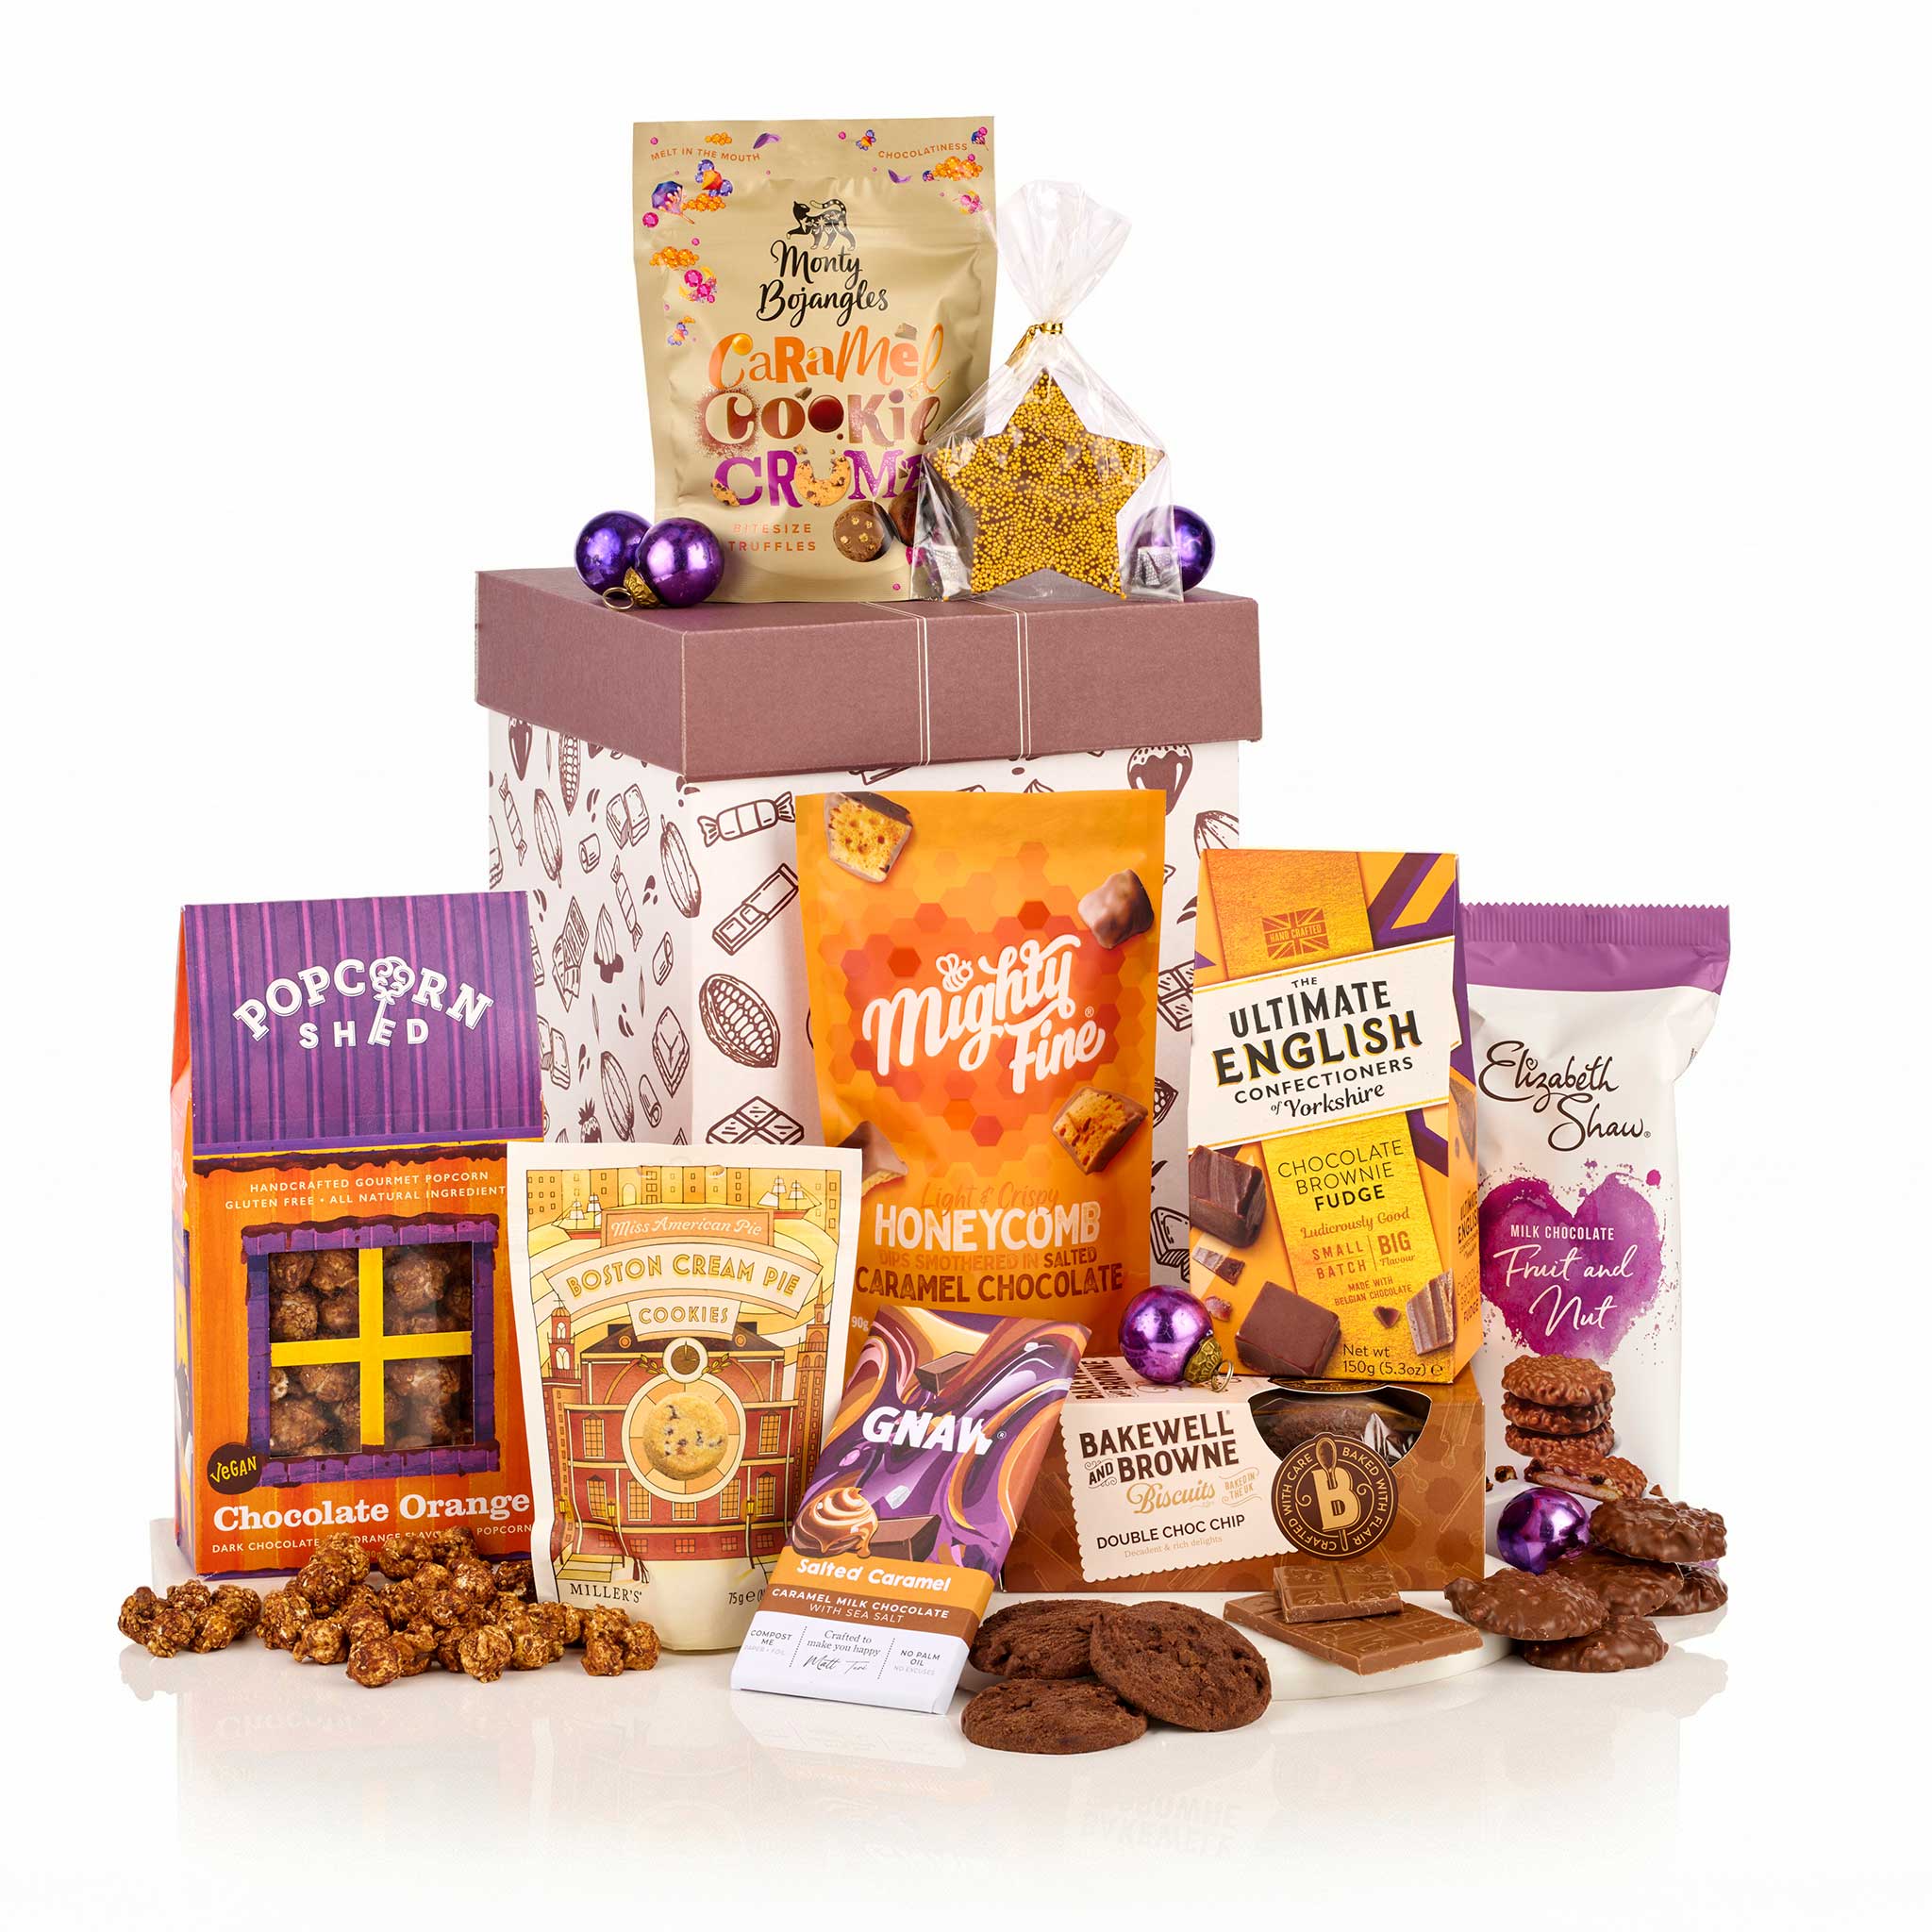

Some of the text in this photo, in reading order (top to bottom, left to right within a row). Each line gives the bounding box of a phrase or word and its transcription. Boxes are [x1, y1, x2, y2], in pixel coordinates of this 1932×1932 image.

[650, 147, 761, 162] MELT IN THE MOUTH
[877, 142, 969, 159] CHOCOLATINESS
[771, 239, 864, 290] Monty
[756, 279, 890, 328] Bojangles
[733, 523, 813, 535] BITESIZE
[727, 540, 817, 552] TRUFFLES
[1269, 924, 1323, 942] HAND CRAFTED
[1291, 976, 1319, 989] THE
[232, 956, 494, 1041] POPCORN
[862, 934, 1081, 1076] Mighty
[1228, 979, 1391, 1039] ULTIMATE
[298, 1018, 430, 1049] SHED
[1210, 1009, 1424, 1087] ENGLISH
[1004, 1011, 1106, 1094] Fine
[1234, 1056, 1414, 1105] CONFECTIONERS
[1478, 1040, 1620, 1113] Elizabeth
[1270, 1084, 1386, 1118] of Yorkshire
[1547, 1092, 1644, 1152] Shaw
[1277, 1139, 1404, 1178] CHOCOLATE
[249, 1171, 489, 1192] HANDCRAFTED GOURMET POPCORN
[1295, 1161, 1394, 1195] BROWNIE
[225, 1197, 278, 1210] GLUTEN
[283, 1195, 315, 1207] FREE
[328, 1192, 354, 1205] ALL
[358, 1190, 421, 1203] NATURAL
[920, 1182, 974, 1216] Light
[998, 1181, 1060, 1215] Crispy
[1314, 1184, 1386, 1211] FUDGE
[611, 1216, 763, 1237] Miss American Pie
[875, 1201, 1101, 1253] HONEYCOMB
[1300, 1207, 1410, 1240] Ludicrously Good
[1509, 1224, 1615, 1241] MILK CHOCOLATE
[1311, 1240, 1365, 1261] SMALL
[1377, 1230, 1412, 1256] BIG
[915, 1253, 1020, 1273] SMOTHERED
[1023, 1252, 1039, 1270] IN
[1043, 1246, 1097, 1269] SALTED
[1316, 1259, 1367, 1280] BATCH
[1378, 1254, 1416, 1267] Flavour
[1493, 1244, 1583, 1287] Fruit
[1583, 1244, 1639, 1278] and
[567, 1253, 800, 1298] BOSTON CREAM PIE
[855, 1262, 1124, 1303] CARAMEL CHOCOLATE
[1347, 1275, 1393, 1292] MADE WITH
[1334, 1284, 1412, 1307] BELGIAN CHOCOLATE
[1529, 1284, 1618, 1337] Nut
[638, 1305, 729, 1324] COOKIES
[851, 1315, 869, 1331] 90g
[1342, 1343, 1390, 1357] Net wt
[1081, 1360, 1131, 1391] BROWNE
[1343, 1360, 1375, 1376] 150g
[1379, 1361, 1427, 1377] (5.3oz)
[862, 1406, 993, 1456] GNAW
[1078, 1410, 1234, 1459] BAKEWELL
[1089, 1439, 1240, 1486] AND BROWNE
[1125, 1478, 1216, 1514] Biscuits
[1224, 1471, 1257, 1491] BAKED IN
[1229, 1482, 1254, 1499] THE UK
[1341, 1446, 1389, 1545] BAKED WITH FLAIR
[212, 1492, 530, 1533] Chocolate Orange
[1281, 1453, 1338, 1552] CRAFTED WITH CARE
[1311, 1466, 1362, 1533] B
[211, 1541, 244, 1554] DARK
[248, 1538, 320, 1551] CHOCOLATE
[476, 1524, 532, 1535] POPCORN
[1096, 1514, 1245, 1549] DOUBLE CHOC CHIP
[1124, 1544, 1163, 1558] Decadent
[1173, 1539, 1190, 1550] rich
[1191, 1535, 1223, 1549] delights
[796, 1558, 952, 1592] Salted Caramel
[728, 1591, 744, 1606] 75g
[772, 1588, 832, 1604] CARAMEL
[836, 1596, 868, 1609] MILK
[872, 1602, 949, 1619] CHOCOLATE
[809, 1604, 905, 1624] WITH SEA SALT
[750, 1629, 793, 1641] COMPOST
[807, 1640, 881, 1657] make you happy
[824, 1630, 861, 1642] Crafted
[916, 1651, 941, 1660] PALM
